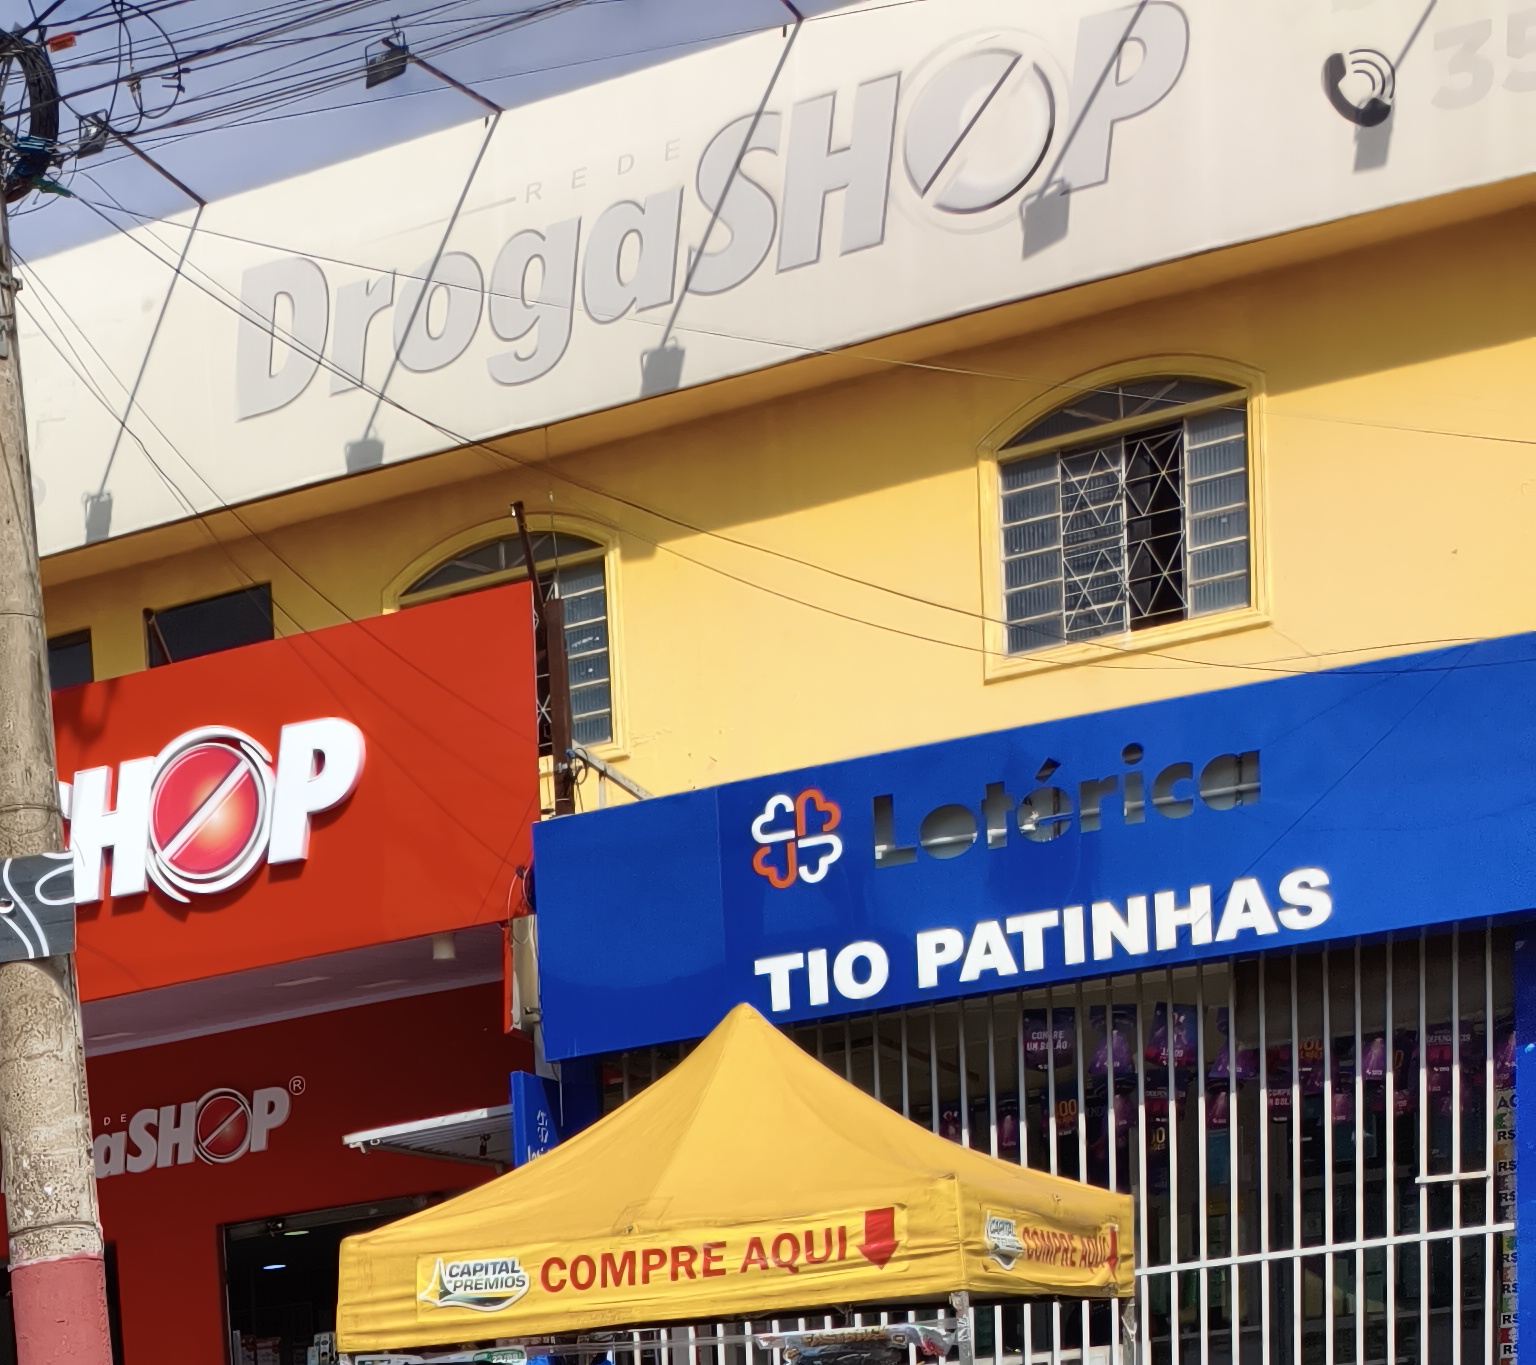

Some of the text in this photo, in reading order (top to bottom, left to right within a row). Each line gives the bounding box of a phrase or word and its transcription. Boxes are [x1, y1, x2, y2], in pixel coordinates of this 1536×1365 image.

[525, 137, 681, 205] REDE
[236, 0, 1189, 422] DrogaSHOP
[873, 742, 1261, 869] Lotérica
[754, 868, 1332, 1012] TIO PATINHAS
[448, 1260, 521, 1278] CAPITAL
[540, 1225, 848, 1293] COMPRE AQUI
[1022, 1226, 1077, 1268] COMPRE
